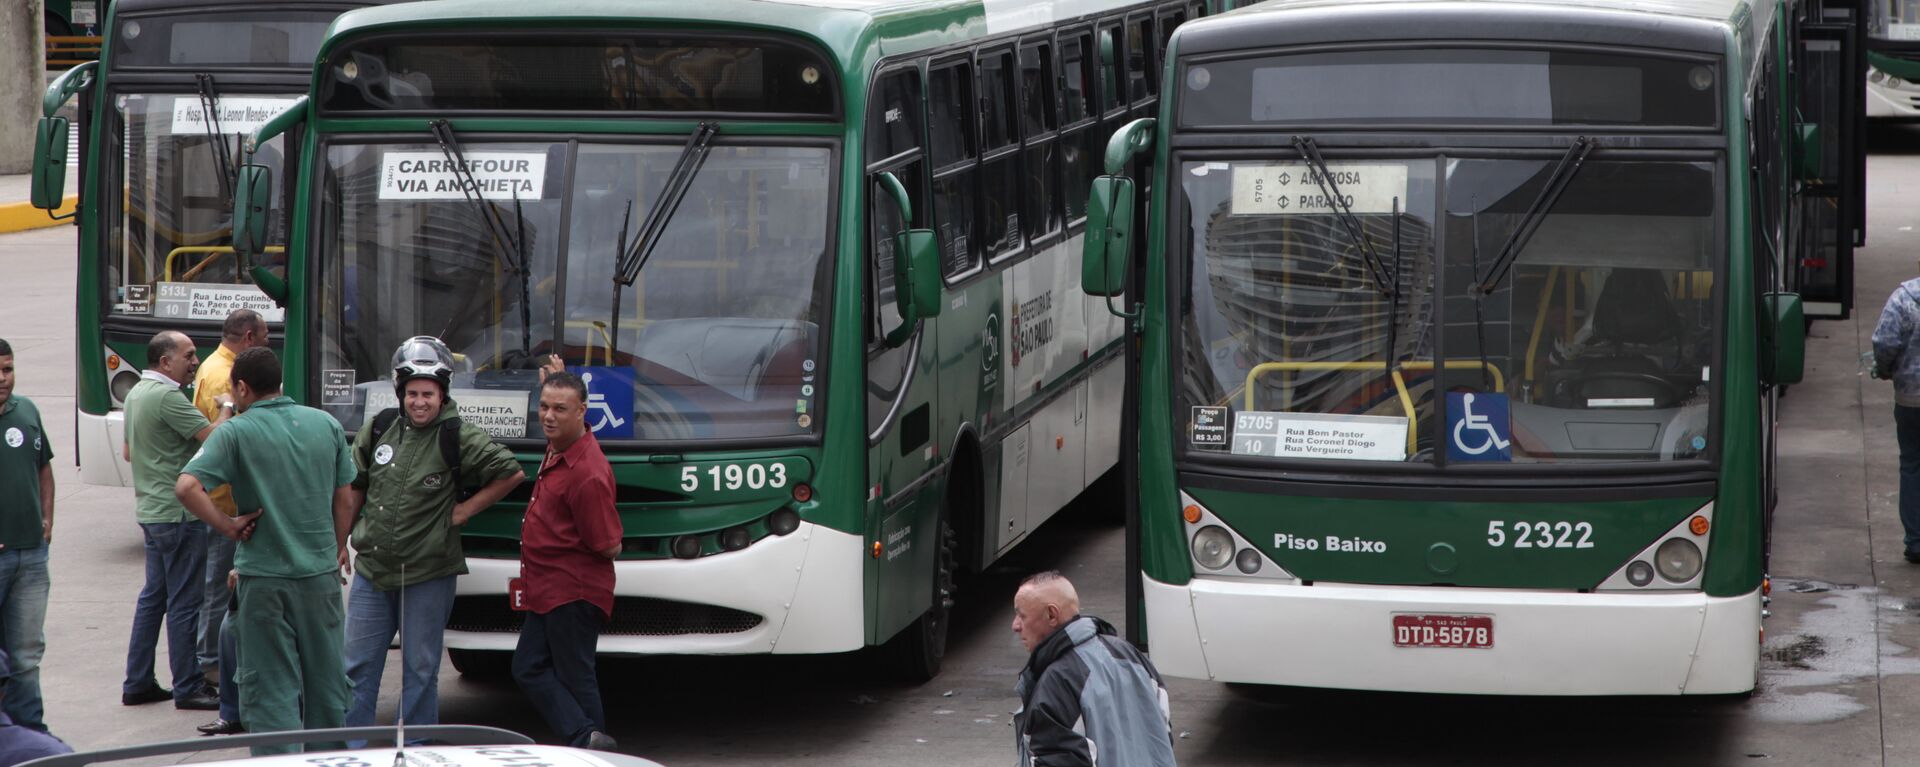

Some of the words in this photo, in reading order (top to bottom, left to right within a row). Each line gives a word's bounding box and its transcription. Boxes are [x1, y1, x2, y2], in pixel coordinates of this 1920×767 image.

[1300, 171, 1325, 185] ANA
[1329, 171, 1361, 185] ROSA
[397, 180, 428, 192] VIA
[435, 179, 533, 192] ANCHIETA
[1255, 178, 1263, 203] 5705
[160, 285, 187, 297] 513L
[193, 293, 209, 301] Rua
[235, 294, 272, 303] Coutinho
[165, 304, 178, 315] 10
[207, 301, 228, 309] Paes
[242, 302, 271, 310] Barros
[192, 308, 208, 316] Rua
[458, 405, 514, 414] NCHIETA
[1194, 424, 1225, 432] Passagem
[1238, 415, 1274, 430] 5705
[1286, 428, 1305, 436] Rua
[1307, 429, 1330, 437] Bom
[1332, 430, 1365, 438] Pastor
[1244, 440, 1262, 453] 10
[1285, 436, 1304, 444] Rua
[1306, 437, 1345, 446] Coronel
[1347, 439, 1376, 449] Diogo
[1284, 444, 1303, 452] Rua
[1306, 445, 1354, 455] Vergueiro
[680, 465, 699, 492] 5
[707, 462, 787, 492] 1903
[1487, 520, 1505, 547] 5
[1513, 521, 1595, 549] 2322
[1274, 533, 1319, 550] Piso
[1326, 536, 1387, 553] Baixo
